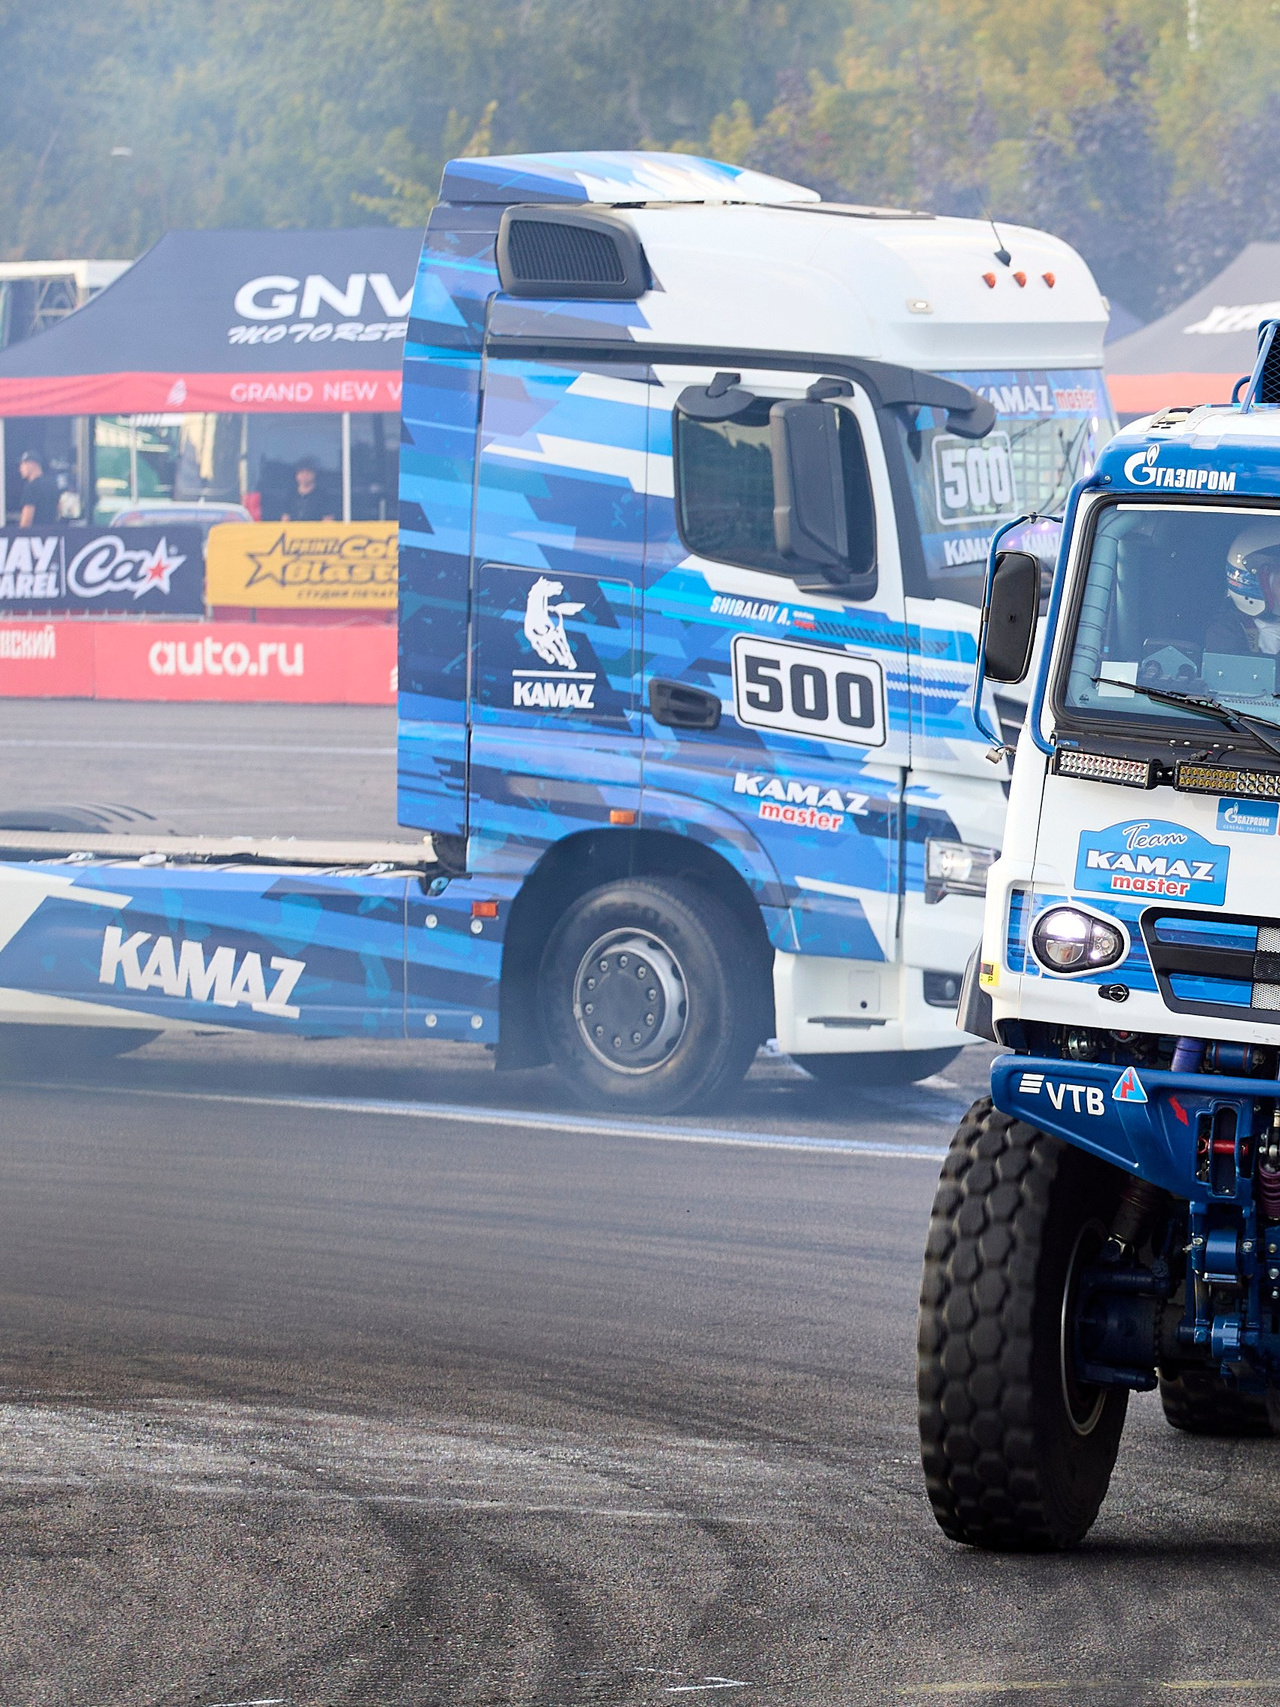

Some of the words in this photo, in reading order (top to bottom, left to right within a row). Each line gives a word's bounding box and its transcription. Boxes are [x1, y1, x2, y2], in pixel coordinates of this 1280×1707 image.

[230, 382, 313, 402] GRAND
[322, 381, 378, 401] NEW
[941, 446, 1010, 509] 500
[710, 595, 779, 624] SHIBALOV
[148, 636, 304, 676] auto.ru
[513, 681, 595, 709] KAMAZ
[744, 654, 875, 729] 500
[733, 772, 870, 816] KAMAZ
[760, 802, 842, 831] master
[1236, 817, 1270, 827] GAZPROM
[1123, 823, 1188, 850] Team
[1087, 850, 1214, 881] KAMAZ
[1112, 875, 1190, 896] master
[99, 925, 306, 1020] KAMAZ
[1045, 1082, 1105, 1116] VTB
